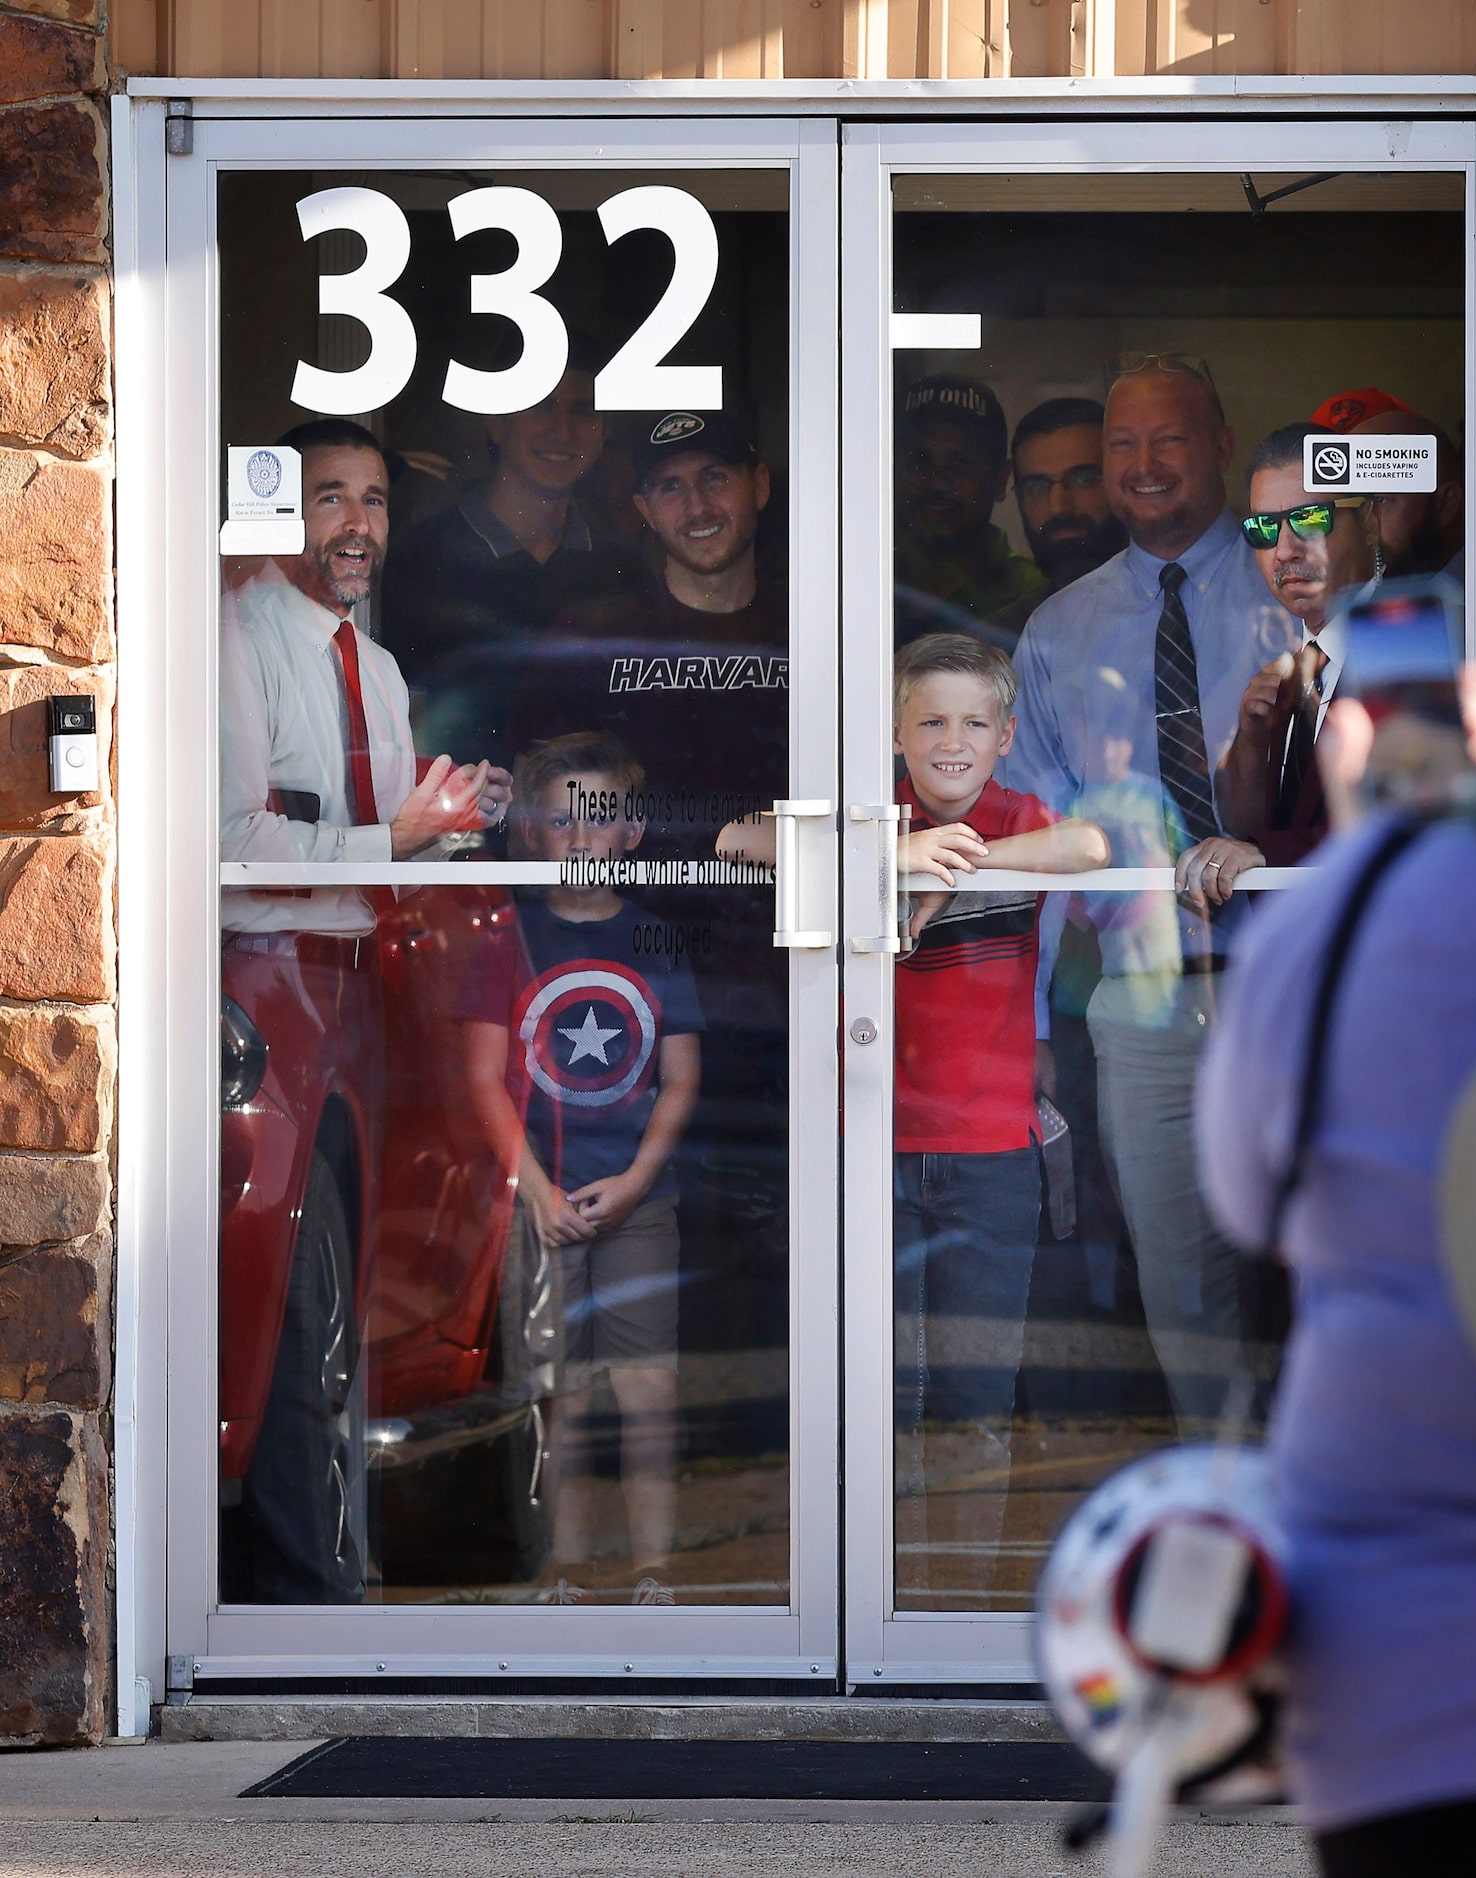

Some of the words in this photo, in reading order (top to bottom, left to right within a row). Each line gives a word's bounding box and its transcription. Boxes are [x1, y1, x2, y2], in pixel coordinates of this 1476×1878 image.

[290, 185, 723, 416] 332
[1356, 449, 1372, 459] NO
[1375, 449, 1429, 459] SMOKING
[567, 780, 618, 822] These
[624, 784, 674, 824] doors
[680, 786, 697, 824] to
[559, 847, 638, 888] unlocked
[645, 848, 690, 888] while
[632, 917, 712, 967] occupied
